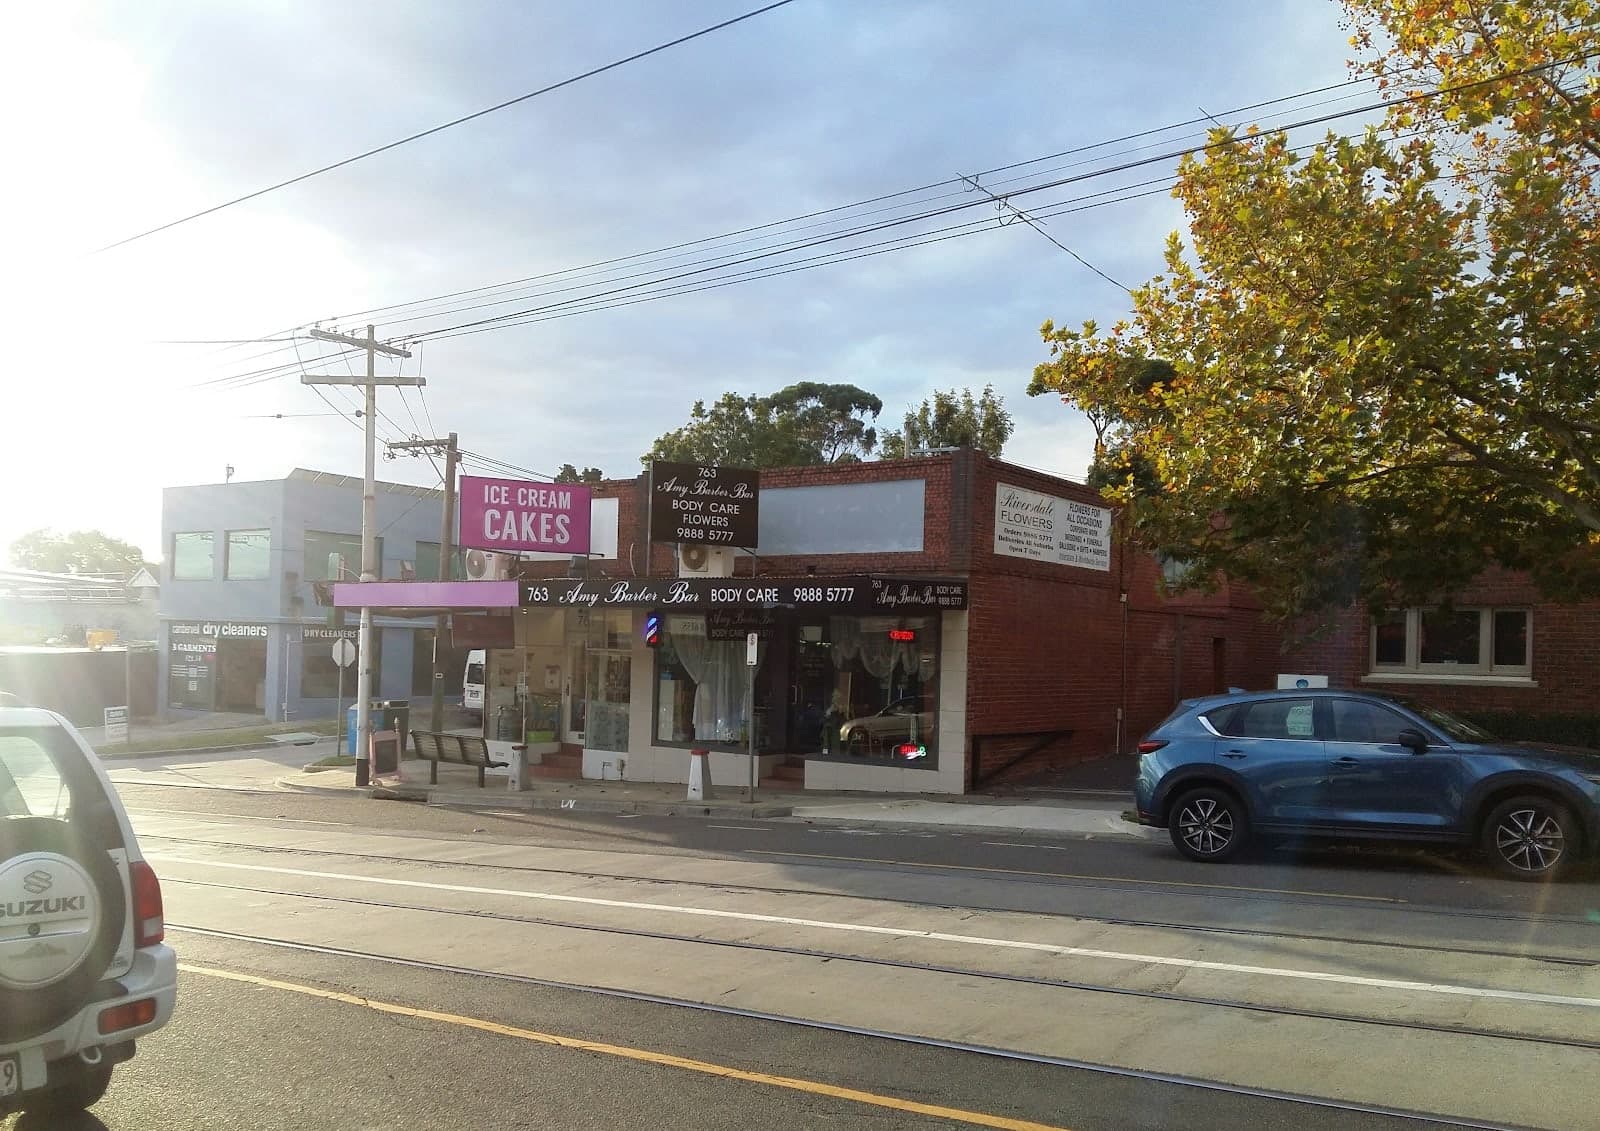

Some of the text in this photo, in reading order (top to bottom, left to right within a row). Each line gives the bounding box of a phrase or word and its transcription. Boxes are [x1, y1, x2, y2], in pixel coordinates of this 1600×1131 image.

[697, 467, 717, 479] 763
[657, 476, 754, 499] Amy Barber Bar
[484, 484, 571, 510] ICE CREAM
[1000, 491, 1054, 516] Riversdale
[672, 499, 740, 514] BODY CARE
[1070, 502, 1090, 516] FLOWERS
[683, 513, 729, 528] FLOWERS
[1001, 510, 1053, 530] FLOWERS
[1066, 512, 1076, 523] ALL
[484, 508, 570, 544] CAKES
[676, 527, 734, 541] 9888 5777
[872, 579, 882, 589] 763
[937, 586, 963, 595] BODY CARE
[527, 580, 855, 607] 763 Amy Barber Bar BODY CARE 9888 5777
[876, 584, 937, 608] Amy Barber Bar
[951, 597, 963, 606] 5777
[203, 622, 221, 638] dry
[222, 622, 268, 637] cleaners
[304, 629, 357, 639] DRY CLEANERS
[889, 631, 915, 641] OPEN
[178, 643, 217, 653] GARMENTS
